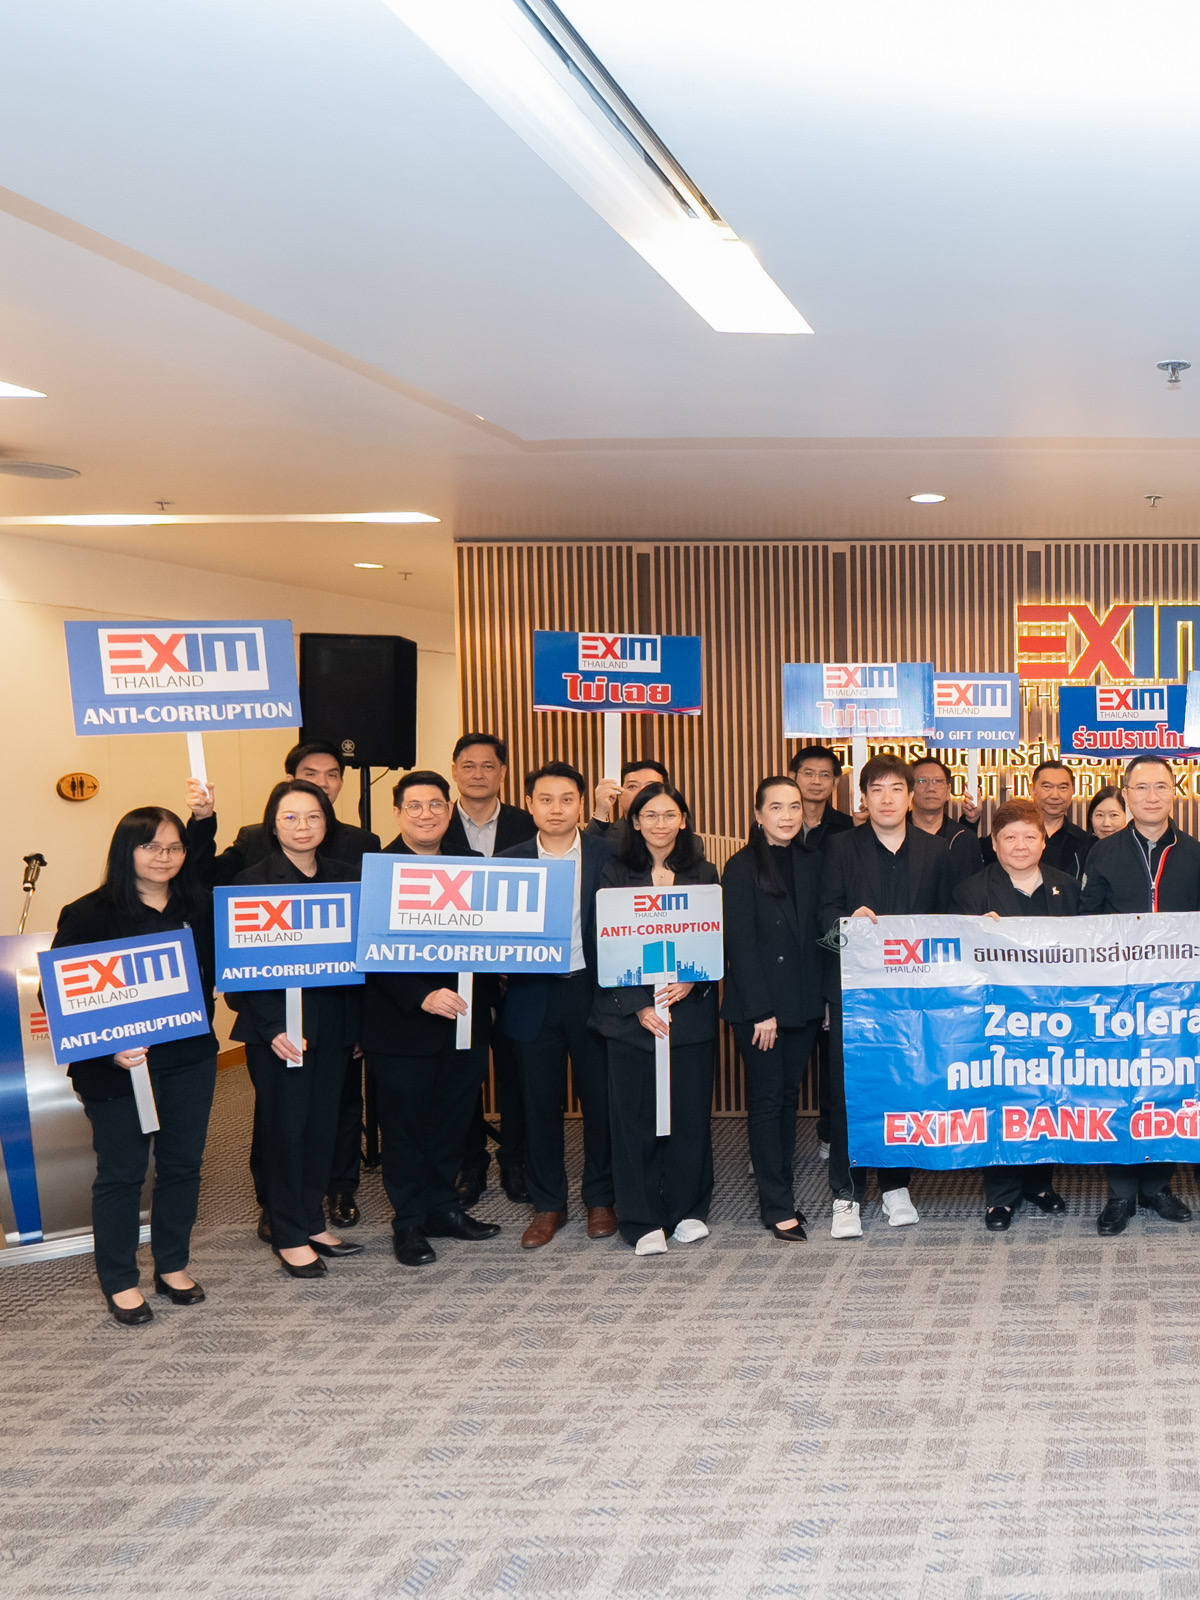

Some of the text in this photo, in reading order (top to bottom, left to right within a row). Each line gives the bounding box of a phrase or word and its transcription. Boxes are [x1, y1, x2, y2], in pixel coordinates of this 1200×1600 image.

[107, 633, 260, 674] EXIM
[581, 636, 658, 661] EXIM
[582, 660, 628, 669] THAILAND
[111, 675, 204, 689] THAILAND
[562, 673, 672, 704] ไม่เฉย
[826, 666, 894, 688] EXIM
[827, 689, 868, 697] THAILAND
[937, 683, 1007, 706] EXIM
[1099, 689, 1164, 710] EXIM
[83, 702, 293, 725] ANTI-CORRUPTION
[816, 701, 901, 728] ไม่ทน
[937, 707, 980, 715] THAILAND
[948, 731, 974, 741] GIFT
[977, 730, 1016, 741] POLICY
[398, 868, 540, 912] EXIM
[634, 893, 688, 912] EXIM
[234, 898, 345, 932] EXIM
[398, 912, 483, 927] THAILAND
[235, 931, 303, 944] THAILAND
[600, 921, 720, 938] ANTI-CORRUPTION
[365, 943, 563, 963] ANTI-CORRUPTION
[883, 937, 961, 965] EXIM
[61, 946, 181, 998] EXIM
[884, 964, 931, 974] THAILAND
[68, 987, 139, 1010] THAILAND
[60, 1010, 203, 1051] ANTI-CORRUPTION
[984, 1004, 1072, 1038] Zero
[883, 1106, 988, 1147] EXIM
[1002, 1104, 1118, 1144] BANK
